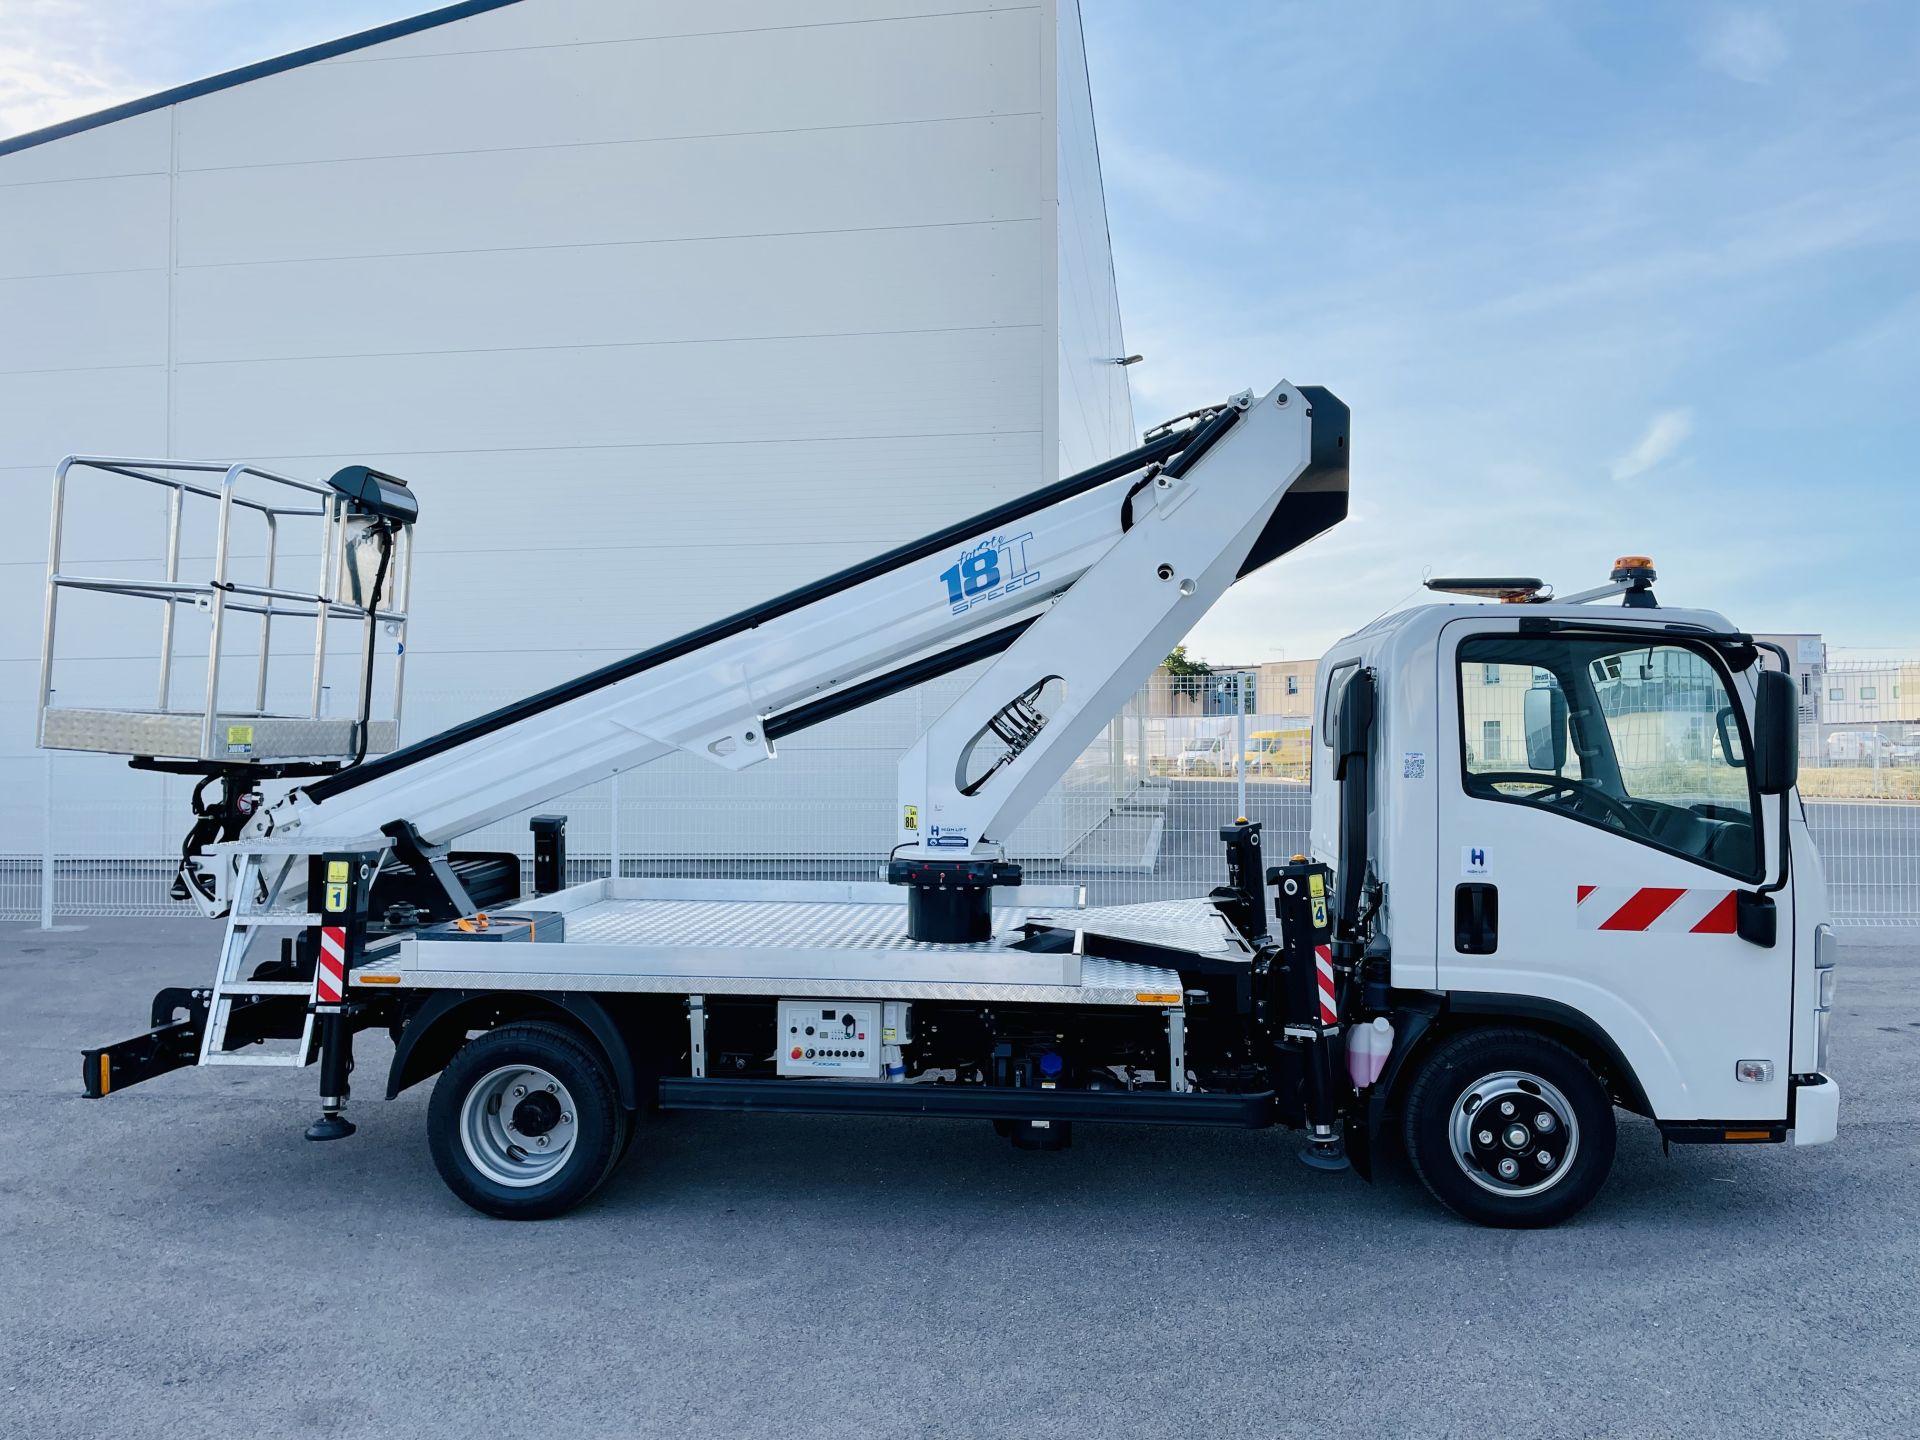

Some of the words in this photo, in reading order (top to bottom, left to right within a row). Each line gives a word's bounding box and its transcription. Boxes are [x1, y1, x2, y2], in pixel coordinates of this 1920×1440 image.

[952, 571, 1040, 616] SPEED
[905, 817, 914, 828] 80
[333, 892, 340, 907] 1
[1315, 906, 1324, 922] 4
